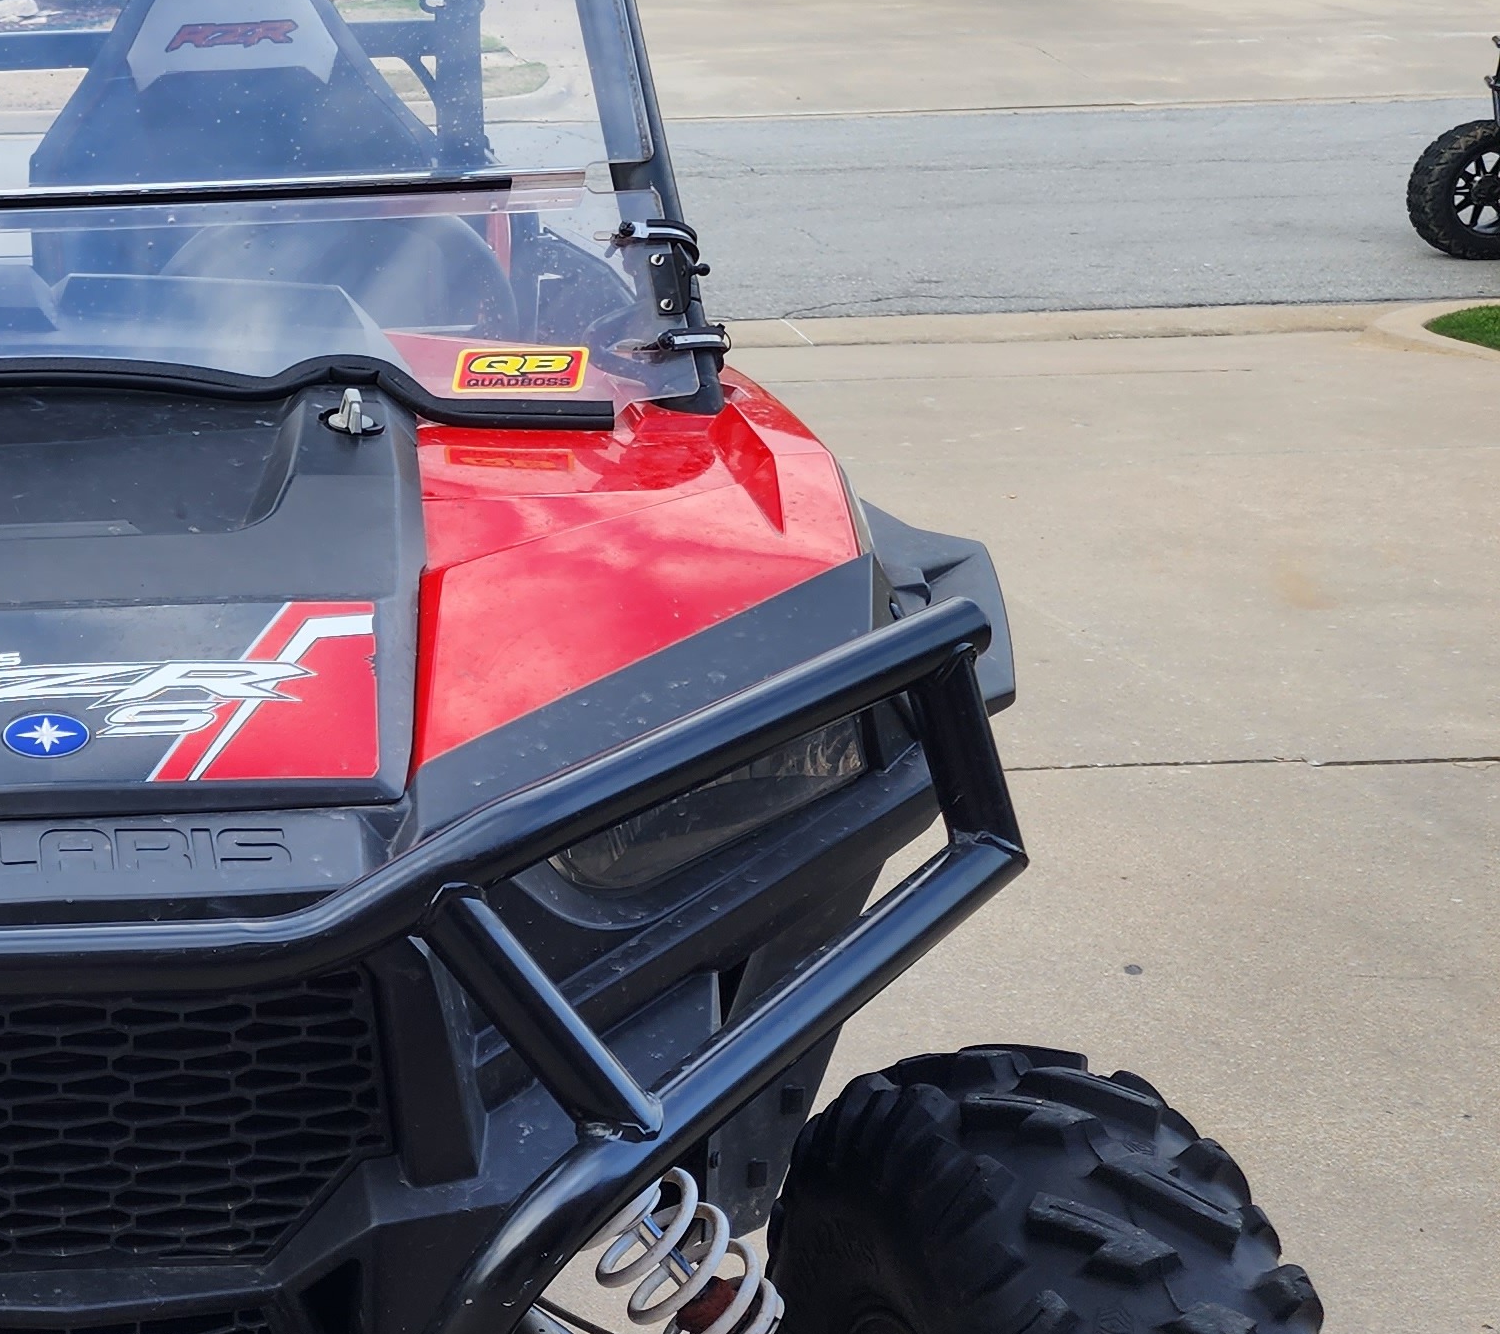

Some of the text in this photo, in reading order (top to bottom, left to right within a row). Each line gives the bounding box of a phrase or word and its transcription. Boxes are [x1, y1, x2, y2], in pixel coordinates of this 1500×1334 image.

[166, 17, 300, 54] RZR
[467, 353, 575, 377] QB
[466, 377, 571, 387] QUADBOSS
